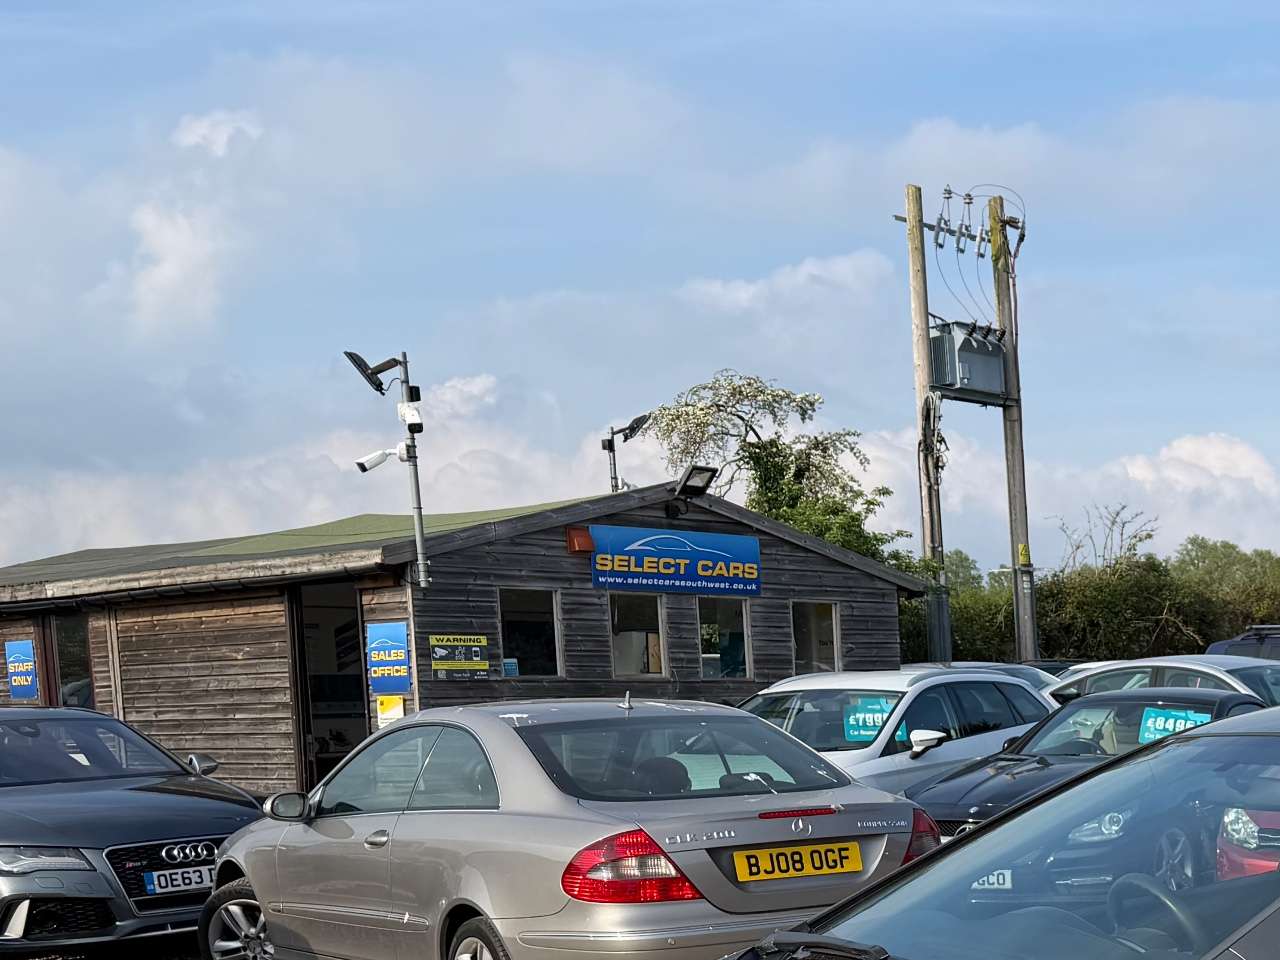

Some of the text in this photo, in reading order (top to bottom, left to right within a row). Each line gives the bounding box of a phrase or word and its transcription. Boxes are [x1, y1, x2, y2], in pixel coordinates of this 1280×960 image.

[595, 554, 758, 579] SELECT CARS
[599, 576, 757, 590] www.selectcarssouthwest.co.uk
[371, 650, 405, 661] SALES
[9, 662, 33, 672] STAFF
[371, 666, 408, 677] OFFICE
[12, 675, 32, 686] ONLY
[746, 847, 850, 876] BJ08 OGF
[157, 870, 204, 889] OE63
